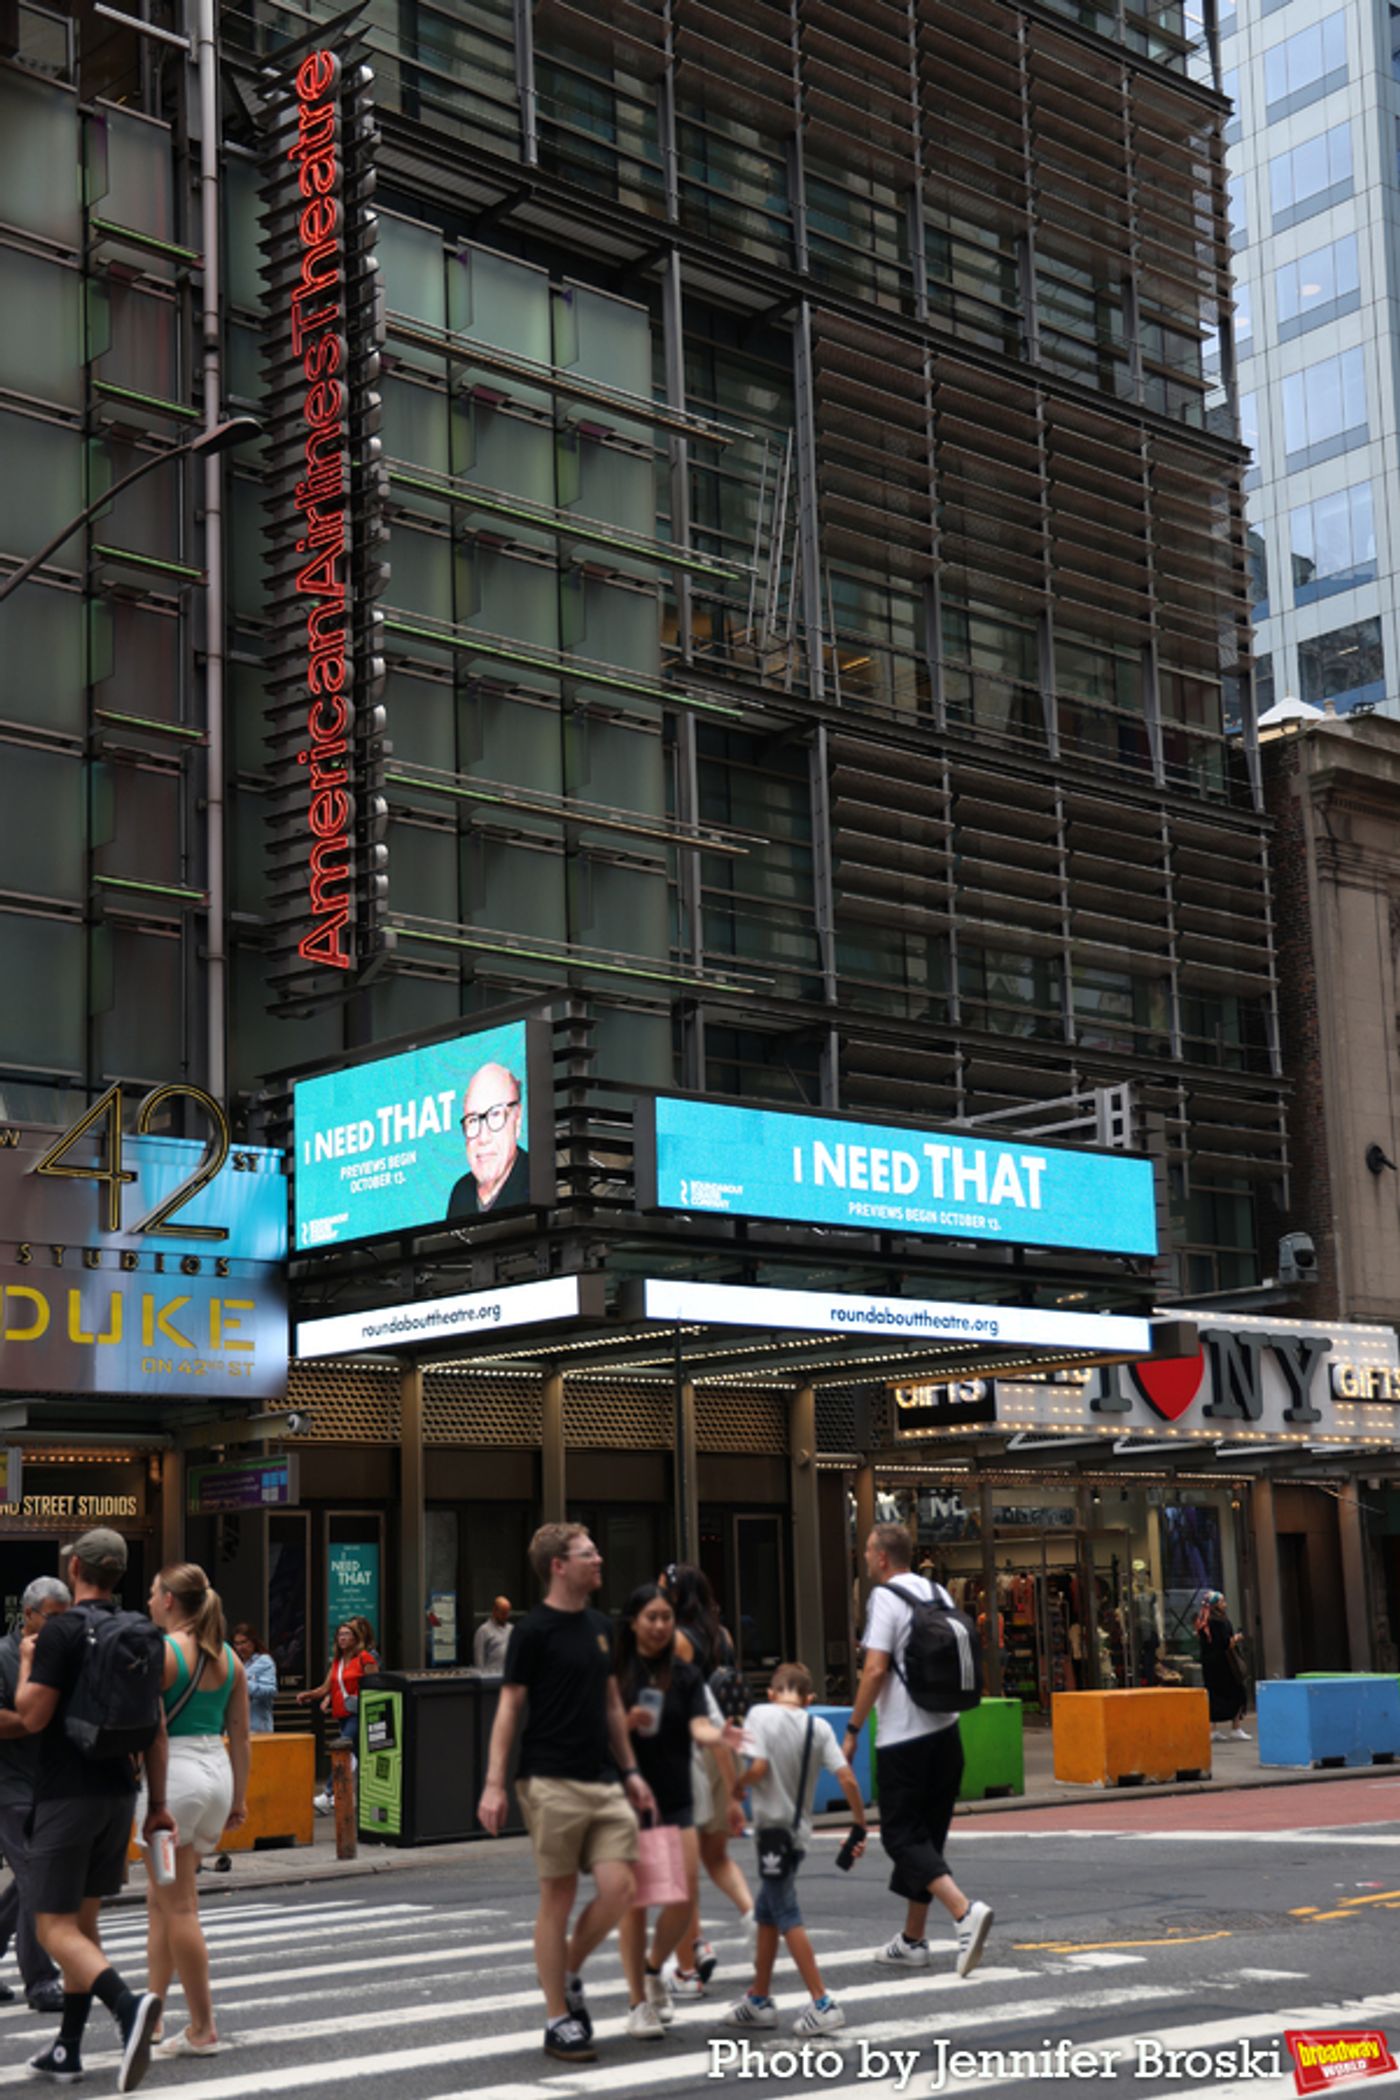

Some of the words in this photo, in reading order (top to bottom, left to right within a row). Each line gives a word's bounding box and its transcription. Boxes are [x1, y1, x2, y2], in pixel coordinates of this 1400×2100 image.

[304, 1140, 310, 1165] I
[314, 1120, 375, 1163] NEED
[376, 1089, 456, 1147] THAT
[26, 1079, 230, 1240] 42
[232, 1152, 259, 1172] ST
[340, 1157, 387, 1181] PREVIEWS
[387, 1151, 417, 1169] BEGIN
[350, 1171, 392, 1194] OCTOBER
[793, 1146, 801, 1183] I
[813, 1141, 919, 1195] NEED
[923, 1142, 1047, 1210] THAT
[848, 1201, 904, 1221] PREVIEWS
[905, 1207, 937, 1223] BEGIN
[940, 1210, 986, 1229] OCTOBER
[17, 1243, 231, 1278] STUDIOS
[0, 1284, 256, 1351] DUKE
[361, 1303, 502, 1338] roundabouttheatre.org
[830, 1306, 999, 1337] roundabouttheatre.org
[141, 1357, 173, 1374] ON
[227, 1360, 256, 1377] ST
[1199, 1329, 1334, 1422] NY
[23, 1495, 75, 1516] STREET
[78, 1495, 137, 1516] STUDIOS
[331, 1560, 360, 1572] NEED
[338, 1570, 372, 1586] THAT
